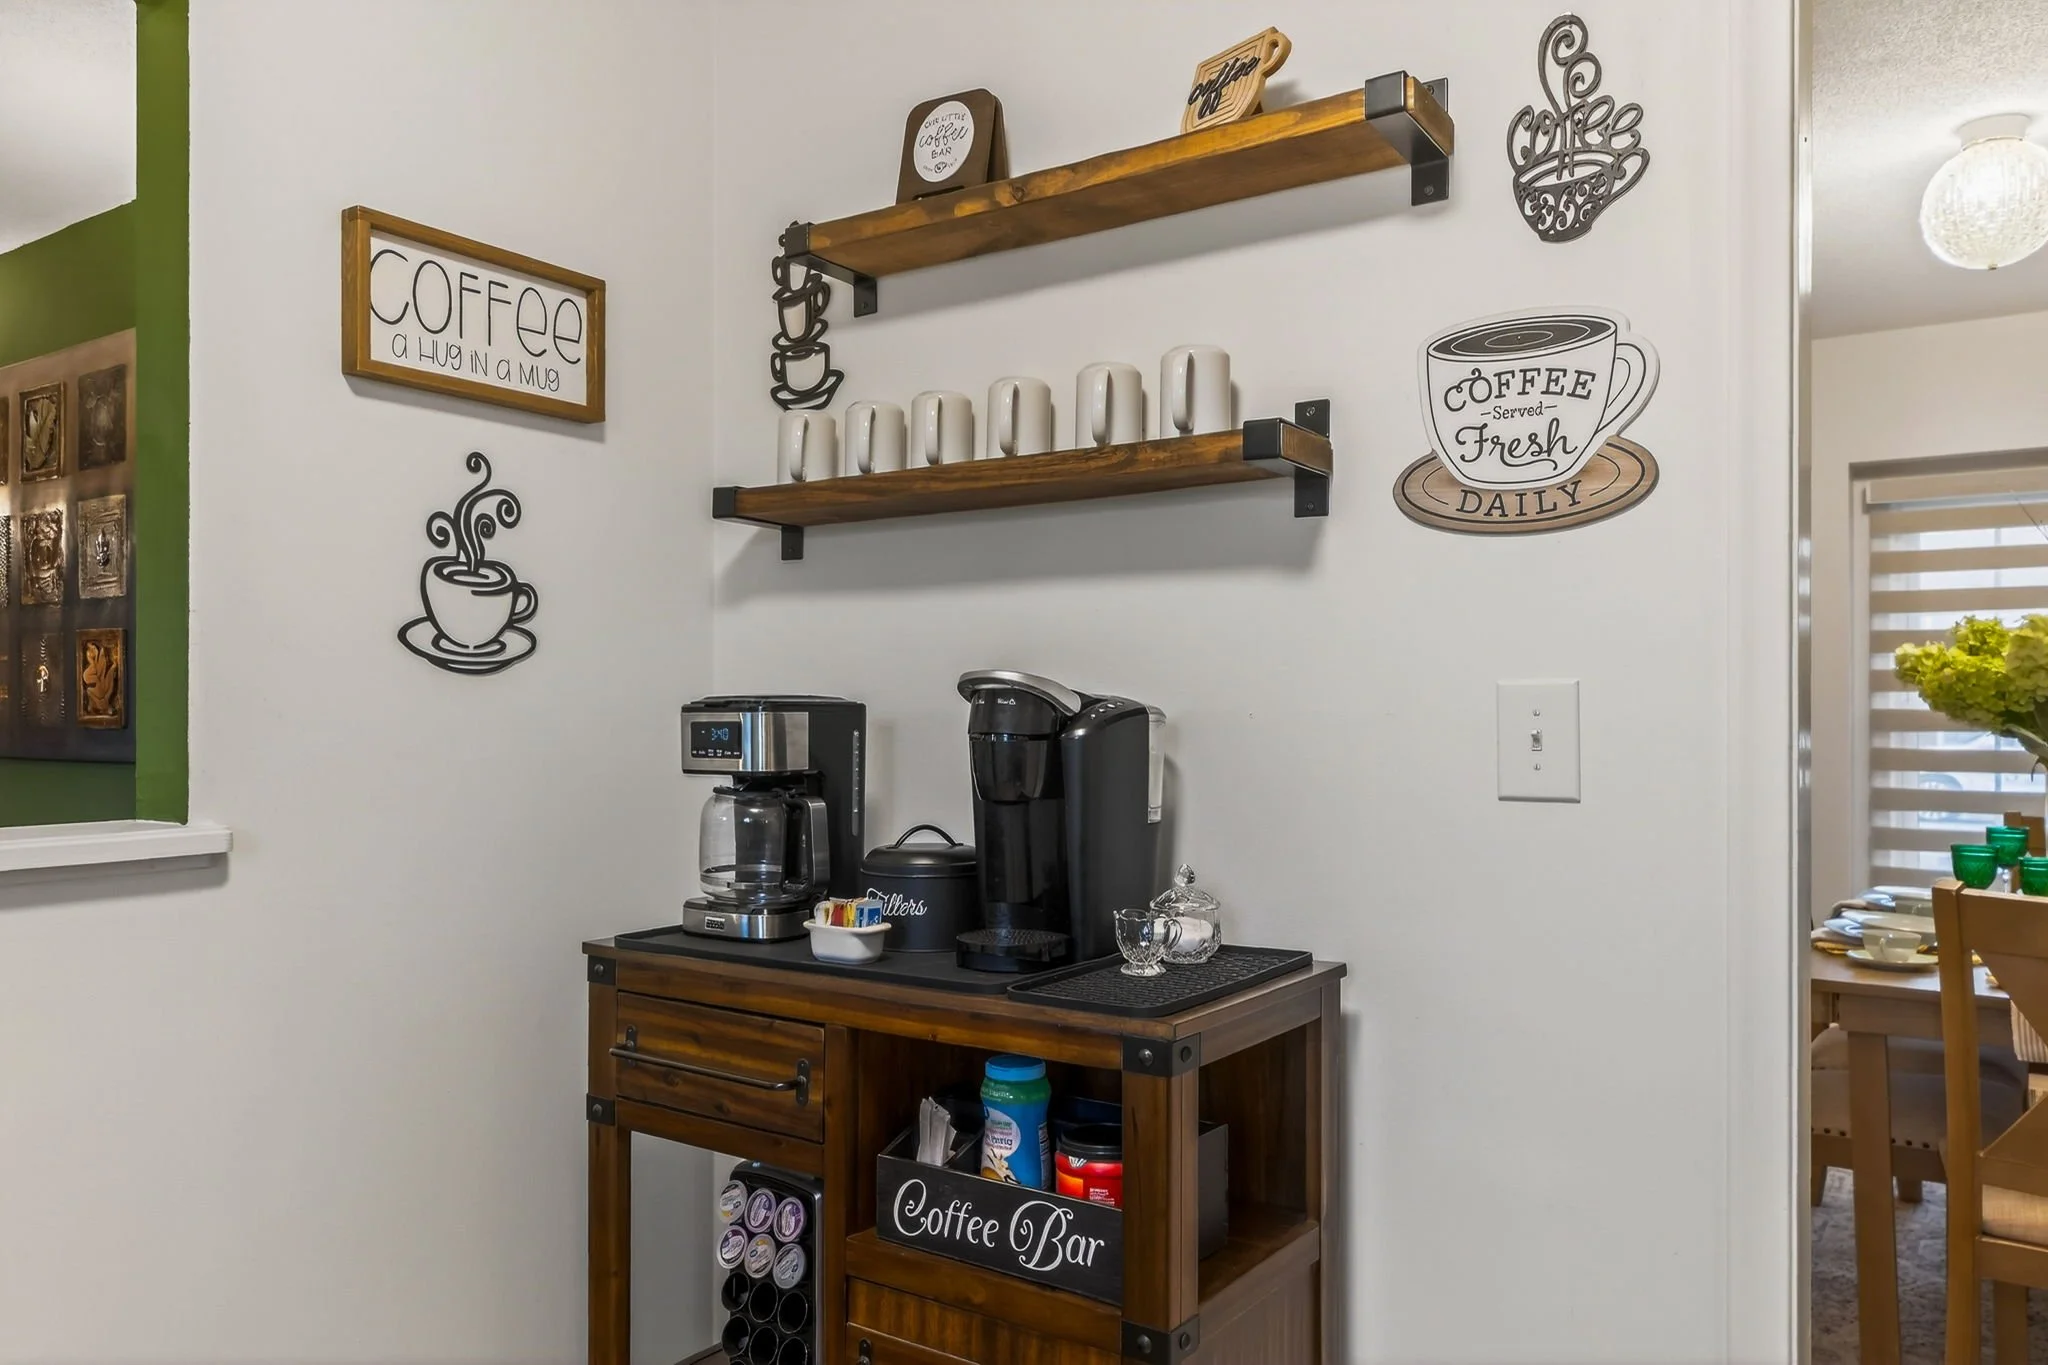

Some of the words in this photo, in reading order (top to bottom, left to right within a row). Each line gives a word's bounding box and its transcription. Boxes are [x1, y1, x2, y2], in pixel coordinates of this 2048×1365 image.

[931, 146, 952, 159] BAR
[1444, 367, 1596, 412] COFFEE
[1455, 417, 1578, 471] Fresh
[1456, 480, 1582, 517] DAILY
[894, 1178, 1000, 1248] Coffee
[1010, 1200, 1105, 1272] Bar
